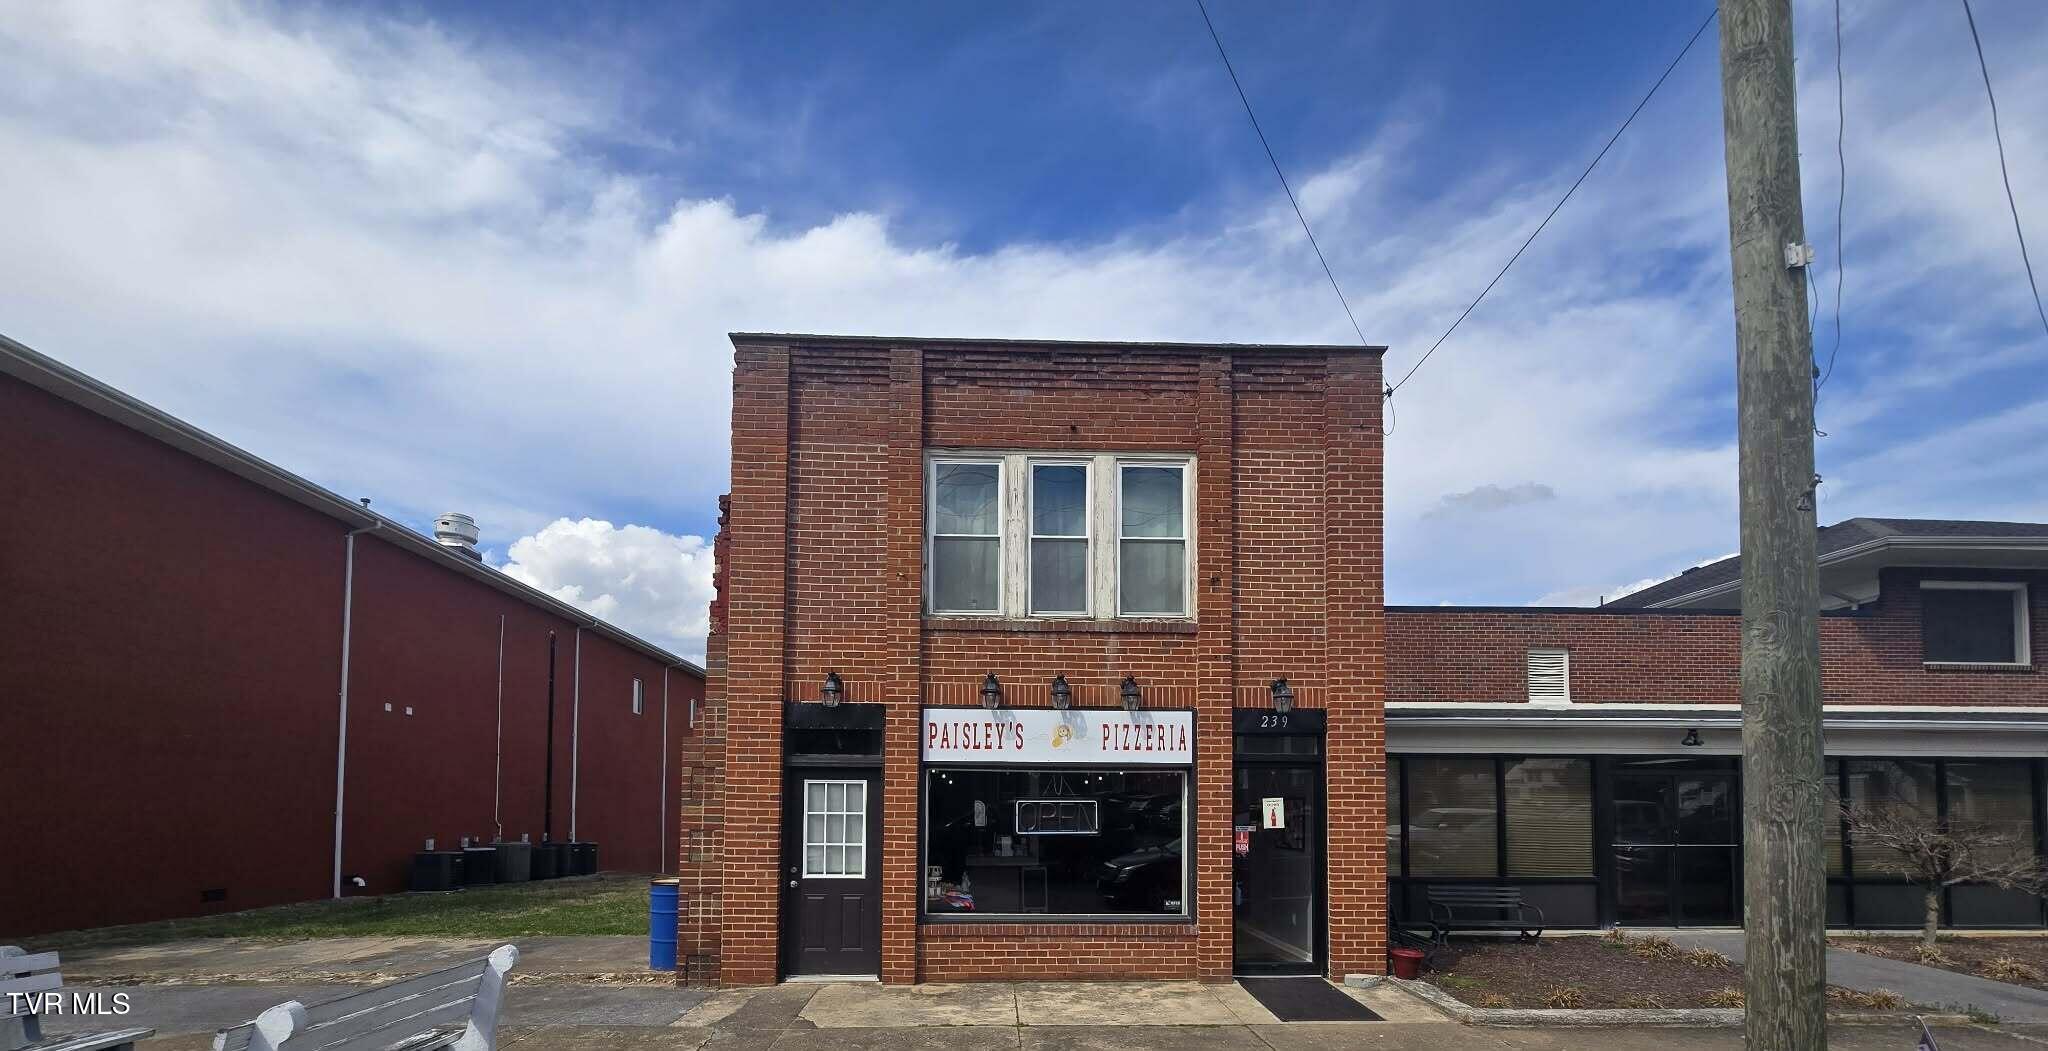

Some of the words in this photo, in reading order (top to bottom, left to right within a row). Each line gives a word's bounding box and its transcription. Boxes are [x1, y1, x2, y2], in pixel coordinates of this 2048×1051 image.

[1261, 715, 1289, 728] 239
[928, 722, 1024, 750] PAISLEY'S
[1102, 723, 1187, 751] PIZZERIA
[1020, 802, 1097, 832] OPEN
